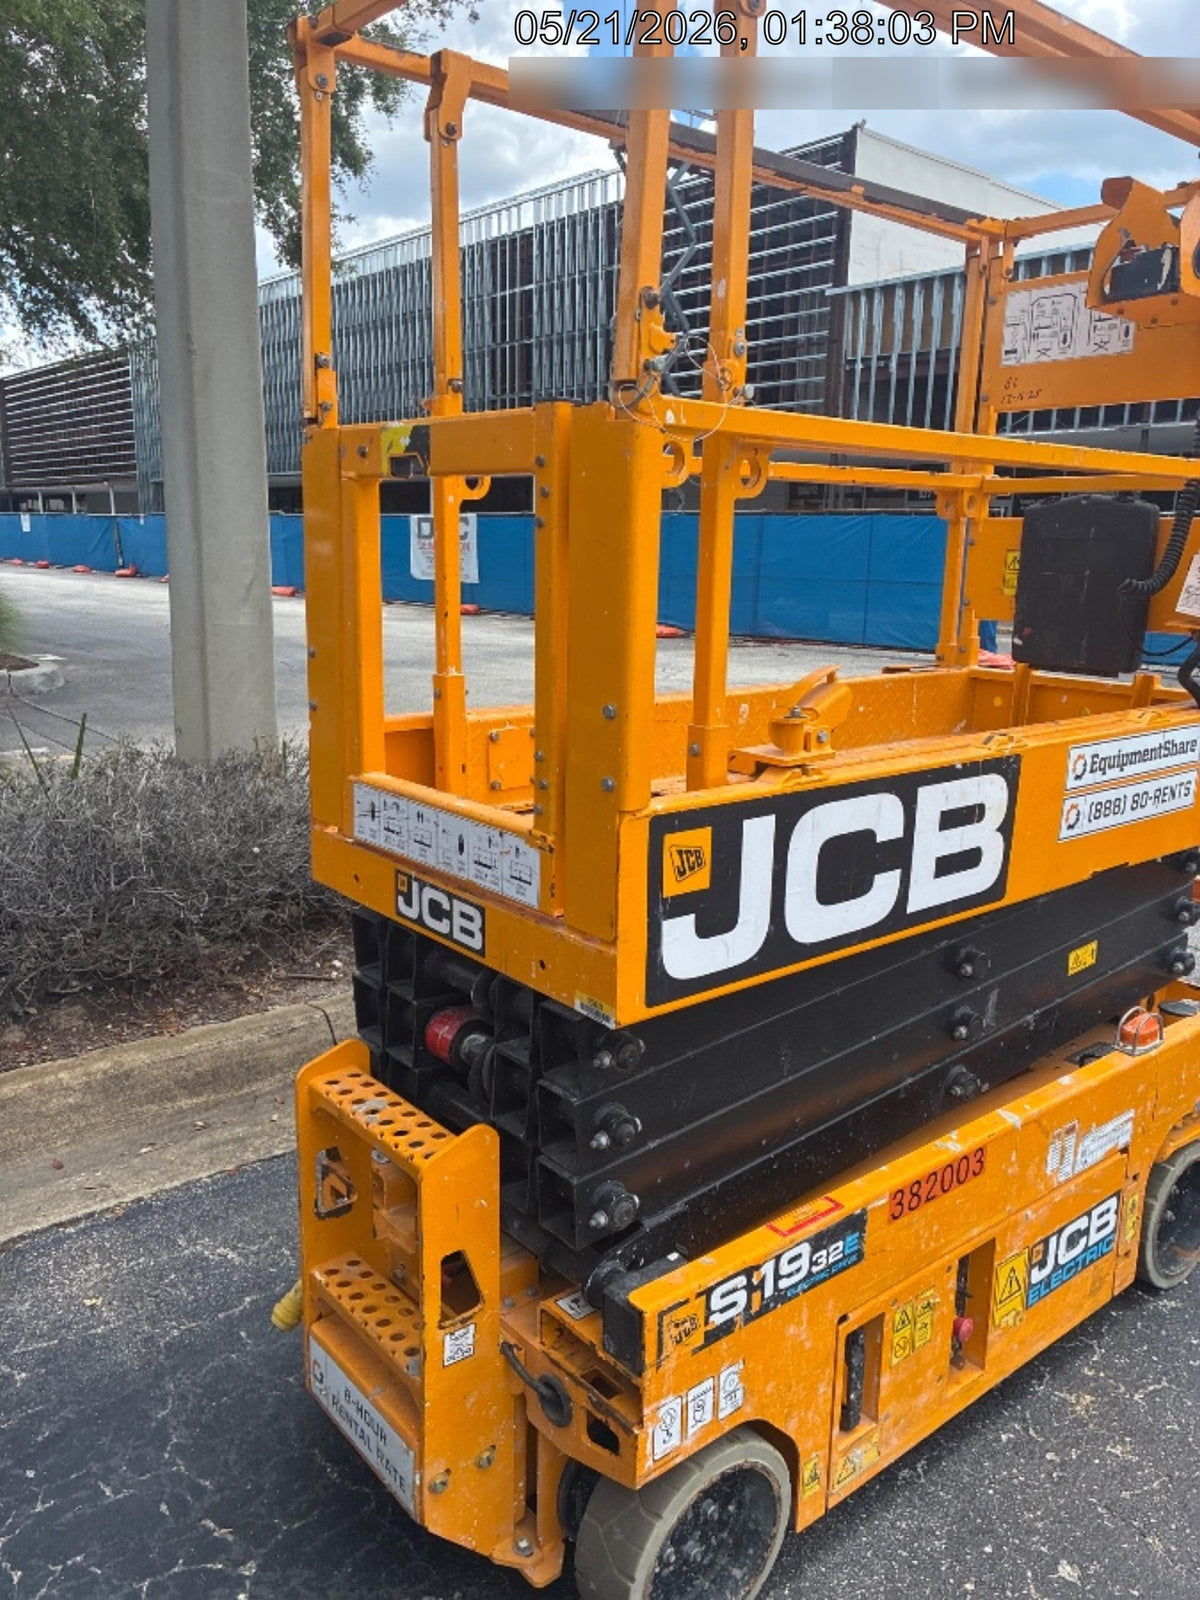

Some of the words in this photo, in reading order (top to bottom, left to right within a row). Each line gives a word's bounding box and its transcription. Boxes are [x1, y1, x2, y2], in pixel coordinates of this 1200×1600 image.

[1089, 739, 1199, 775] EquipmentShare
[1087, 794, 1127, 823] (888)
[661, 772, 1009, 980] JCB
[675, 848, 703, 878] JCB
[397, 880, 483, 951] JCB
[891, 1147, 985, 1220] 382003
[1027, 1233, 1115, 1310] ELECTRIC
[1030, 1196, 1118, 1285] JCB
[331, 1393, 373, 1452] RENTAL
[375, 1446, 407, 1495] RATE
[343, 1386, 387, 1447] 8-HOUR
